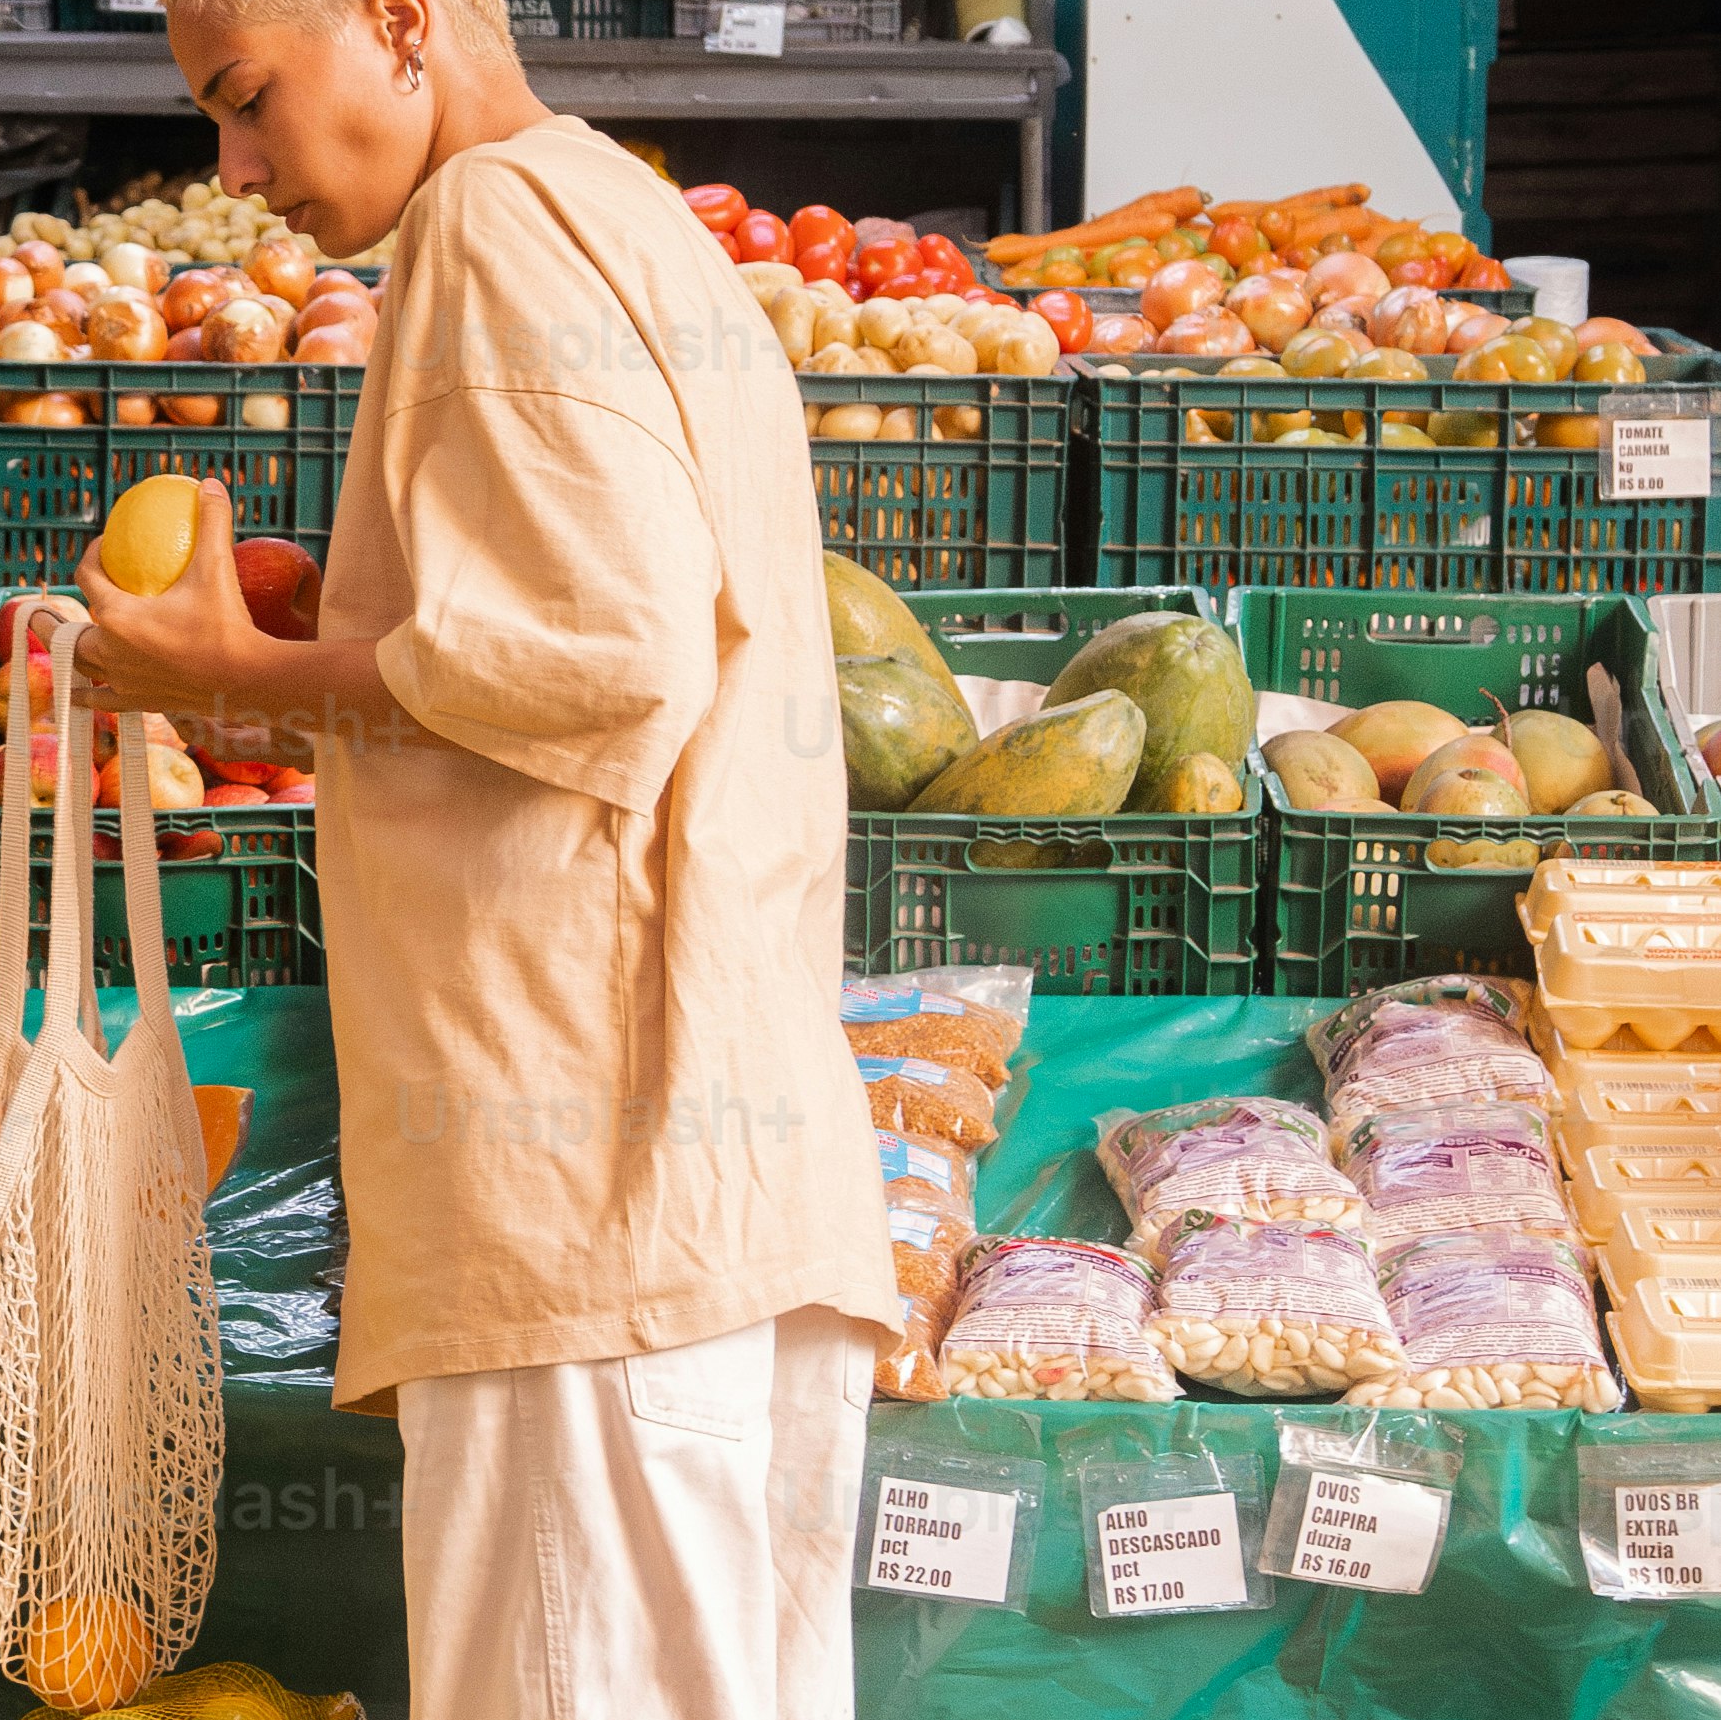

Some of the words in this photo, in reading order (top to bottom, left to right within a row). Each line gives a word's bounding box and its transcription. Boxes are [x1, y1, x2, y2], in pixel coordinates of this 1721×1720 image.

[509, 0, 553, 16] ASA
[1618, 426, 1664, 439] TOMATE
[1618, 443, 1670, 457] CARMEM
[1618, 461, 1634, 474] kg
[1619, 477, 1634, 491] R$
[886, 1487, 928, 1510] ALHO
[1316, 1481, 1360, 1505] OVOS
[1625, 1493, 1671, 1511] OVOS
[1675, 1493, 1699, 1511] BR
[884, 1513, 962, 1541] TORRADO
[1105, 1509, 1148, 1531] ALHO
[1311, 1506, 1378, 1534] CAIPIRA
[1625, 1519, 1679, 1537] EXTRA
[880, 1537, 909, 1557] pct
[1108, 1528, 1221, 1557] DESCASCADO
[1305, 1528, 1352, 1552] duzia
[1626, 1542, 1674, 1560] duzia
[877, 1561, 899, 1582] R$
[904, 1564, 952, 1588] 22,00
[1111, 1560, 1140, 1580] pct
[1300, 1553, 1323, 1573] R$
[1326, 1558, 1371, 1580] 16,00
[1628, 1566, 1651, 1586] R$
[1655, 1566, 1703, 1586] 10,00
[1115, 1586, 1137, 1606] R$
[1141, 1581, 1184, 1603] 17,00
